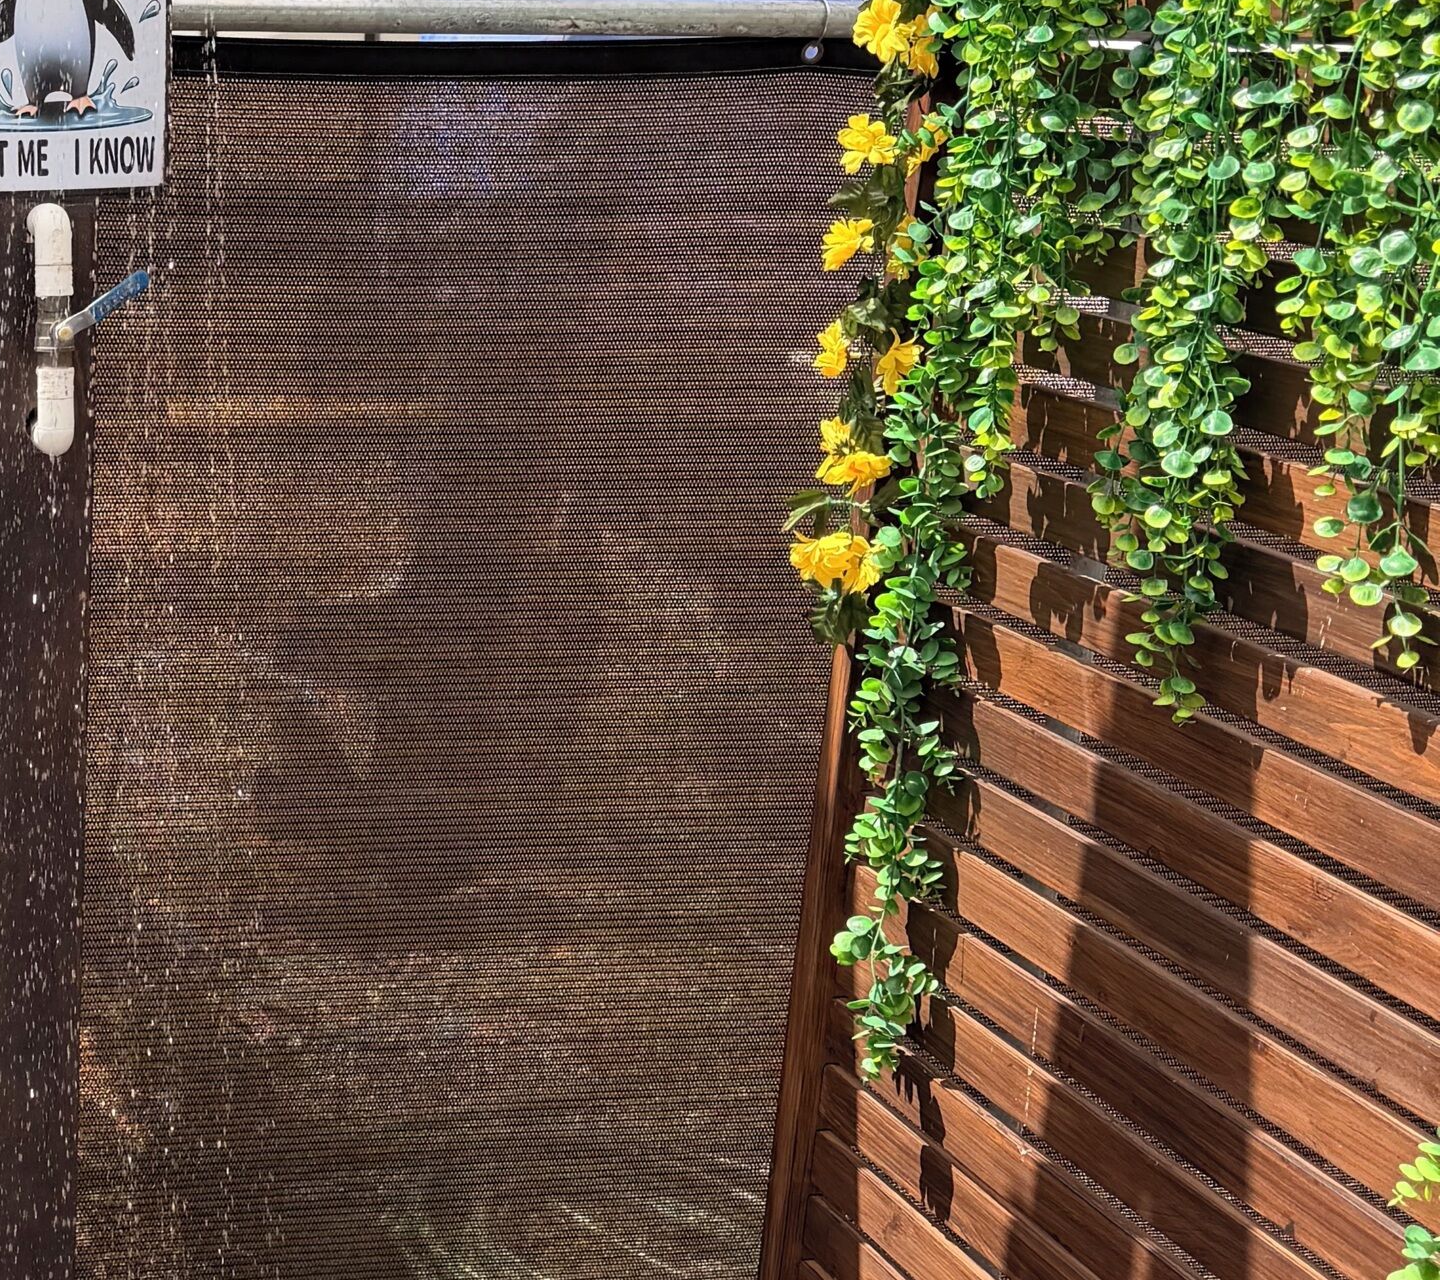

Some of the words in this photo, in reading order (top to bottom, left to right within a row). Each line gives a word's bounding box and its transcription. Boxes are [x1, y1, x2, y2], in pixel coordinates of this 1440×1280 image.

[17, 139, 50, 176] ME
[74, 138, 81, 175] I
[88, 136, 155, 174] KNOW
